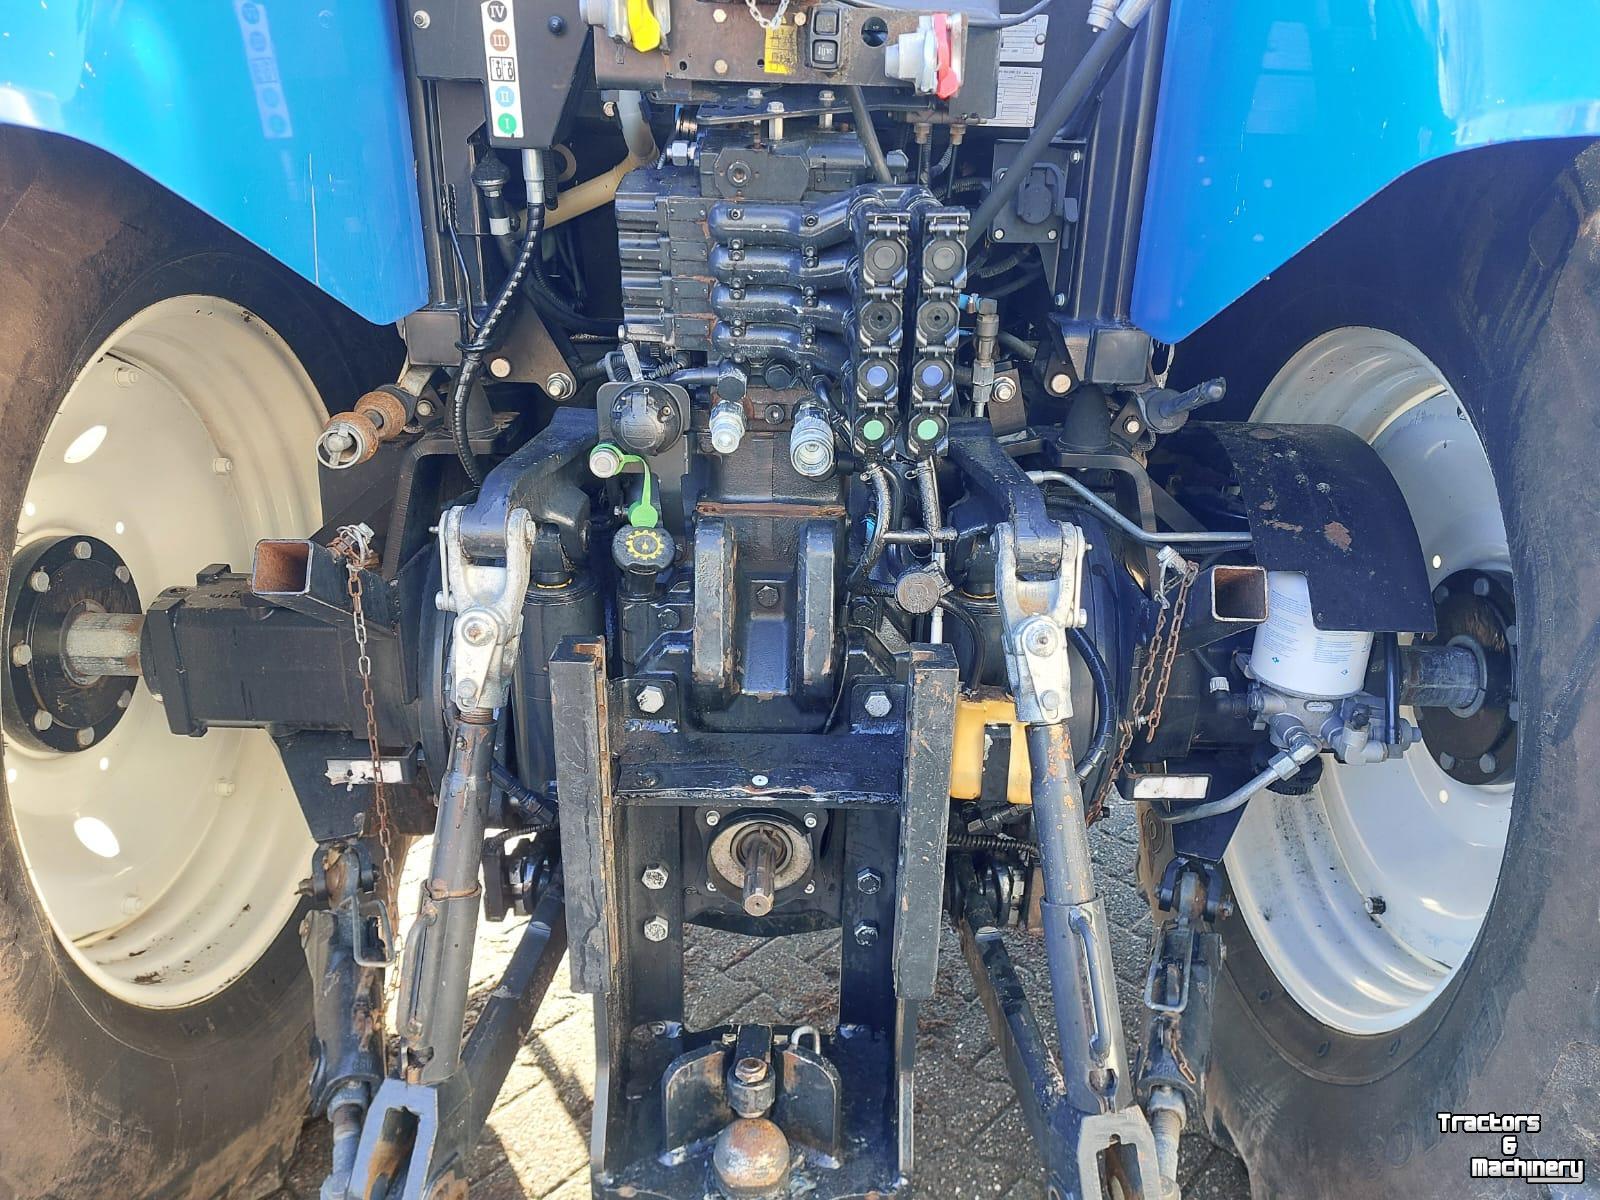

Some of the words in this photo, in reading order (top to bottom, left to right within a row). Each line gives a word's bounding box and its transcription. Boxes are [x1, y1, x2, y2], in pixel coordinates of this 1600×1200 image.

[490, 5, 505, 18] IV
[492, 34, 506, 47] III
[500, 91, 510, 102] II
